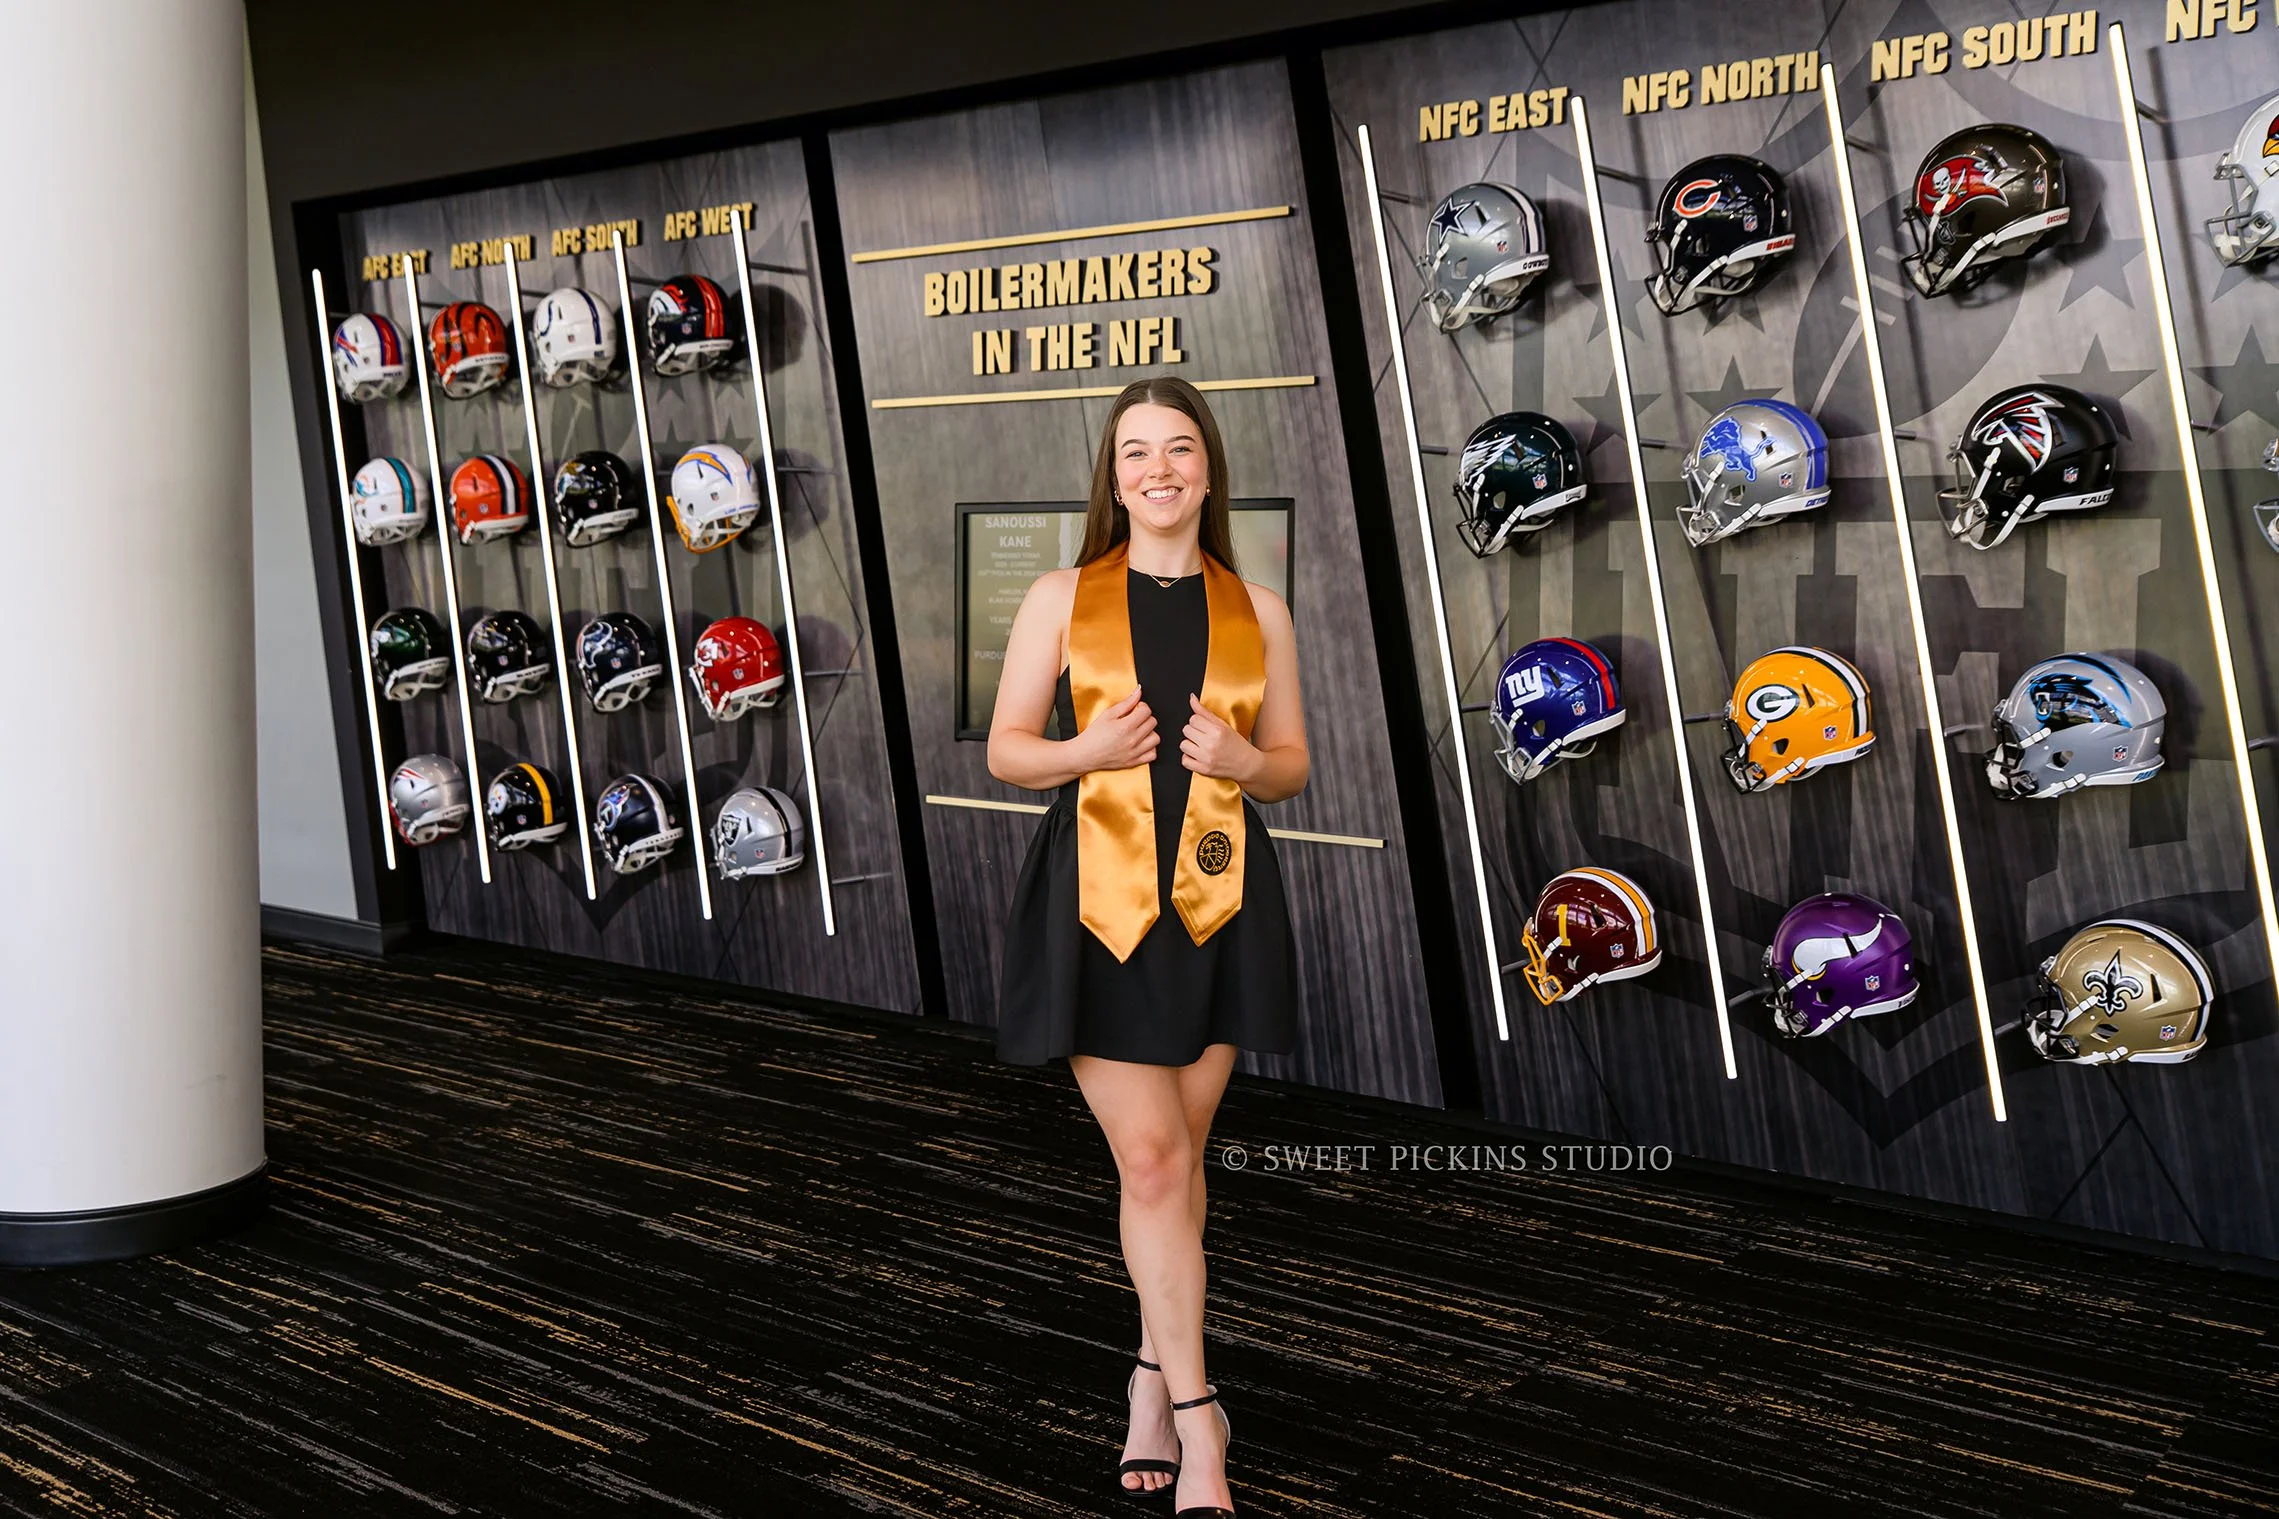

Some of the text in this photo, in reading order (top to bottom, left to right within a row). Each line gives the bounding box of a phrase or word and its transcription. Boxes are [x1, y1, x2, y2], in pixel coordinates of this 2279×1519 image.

[2166, 0, 2257, 42] NFC
[1871, 9, 2097, 82] NFC SOUTH
[1622, 50, 1819, 115] NFC NORTH
[1418, 86, 1568, 142] NFC EAST
[552, 227, 581, 257] AFC
[664, 210, 697, 242] AFC
[362, 249, 428, 282] AFC EST
[450, 241, 479, 270] AFC
[924, 246, 1214, 317] BOILERMAKERS
[972, 315, 1182, 376] IN THE NFL
[984, 516, 1047, 528] SANOUSSI
[999, 535, 1032, 548] KANE
